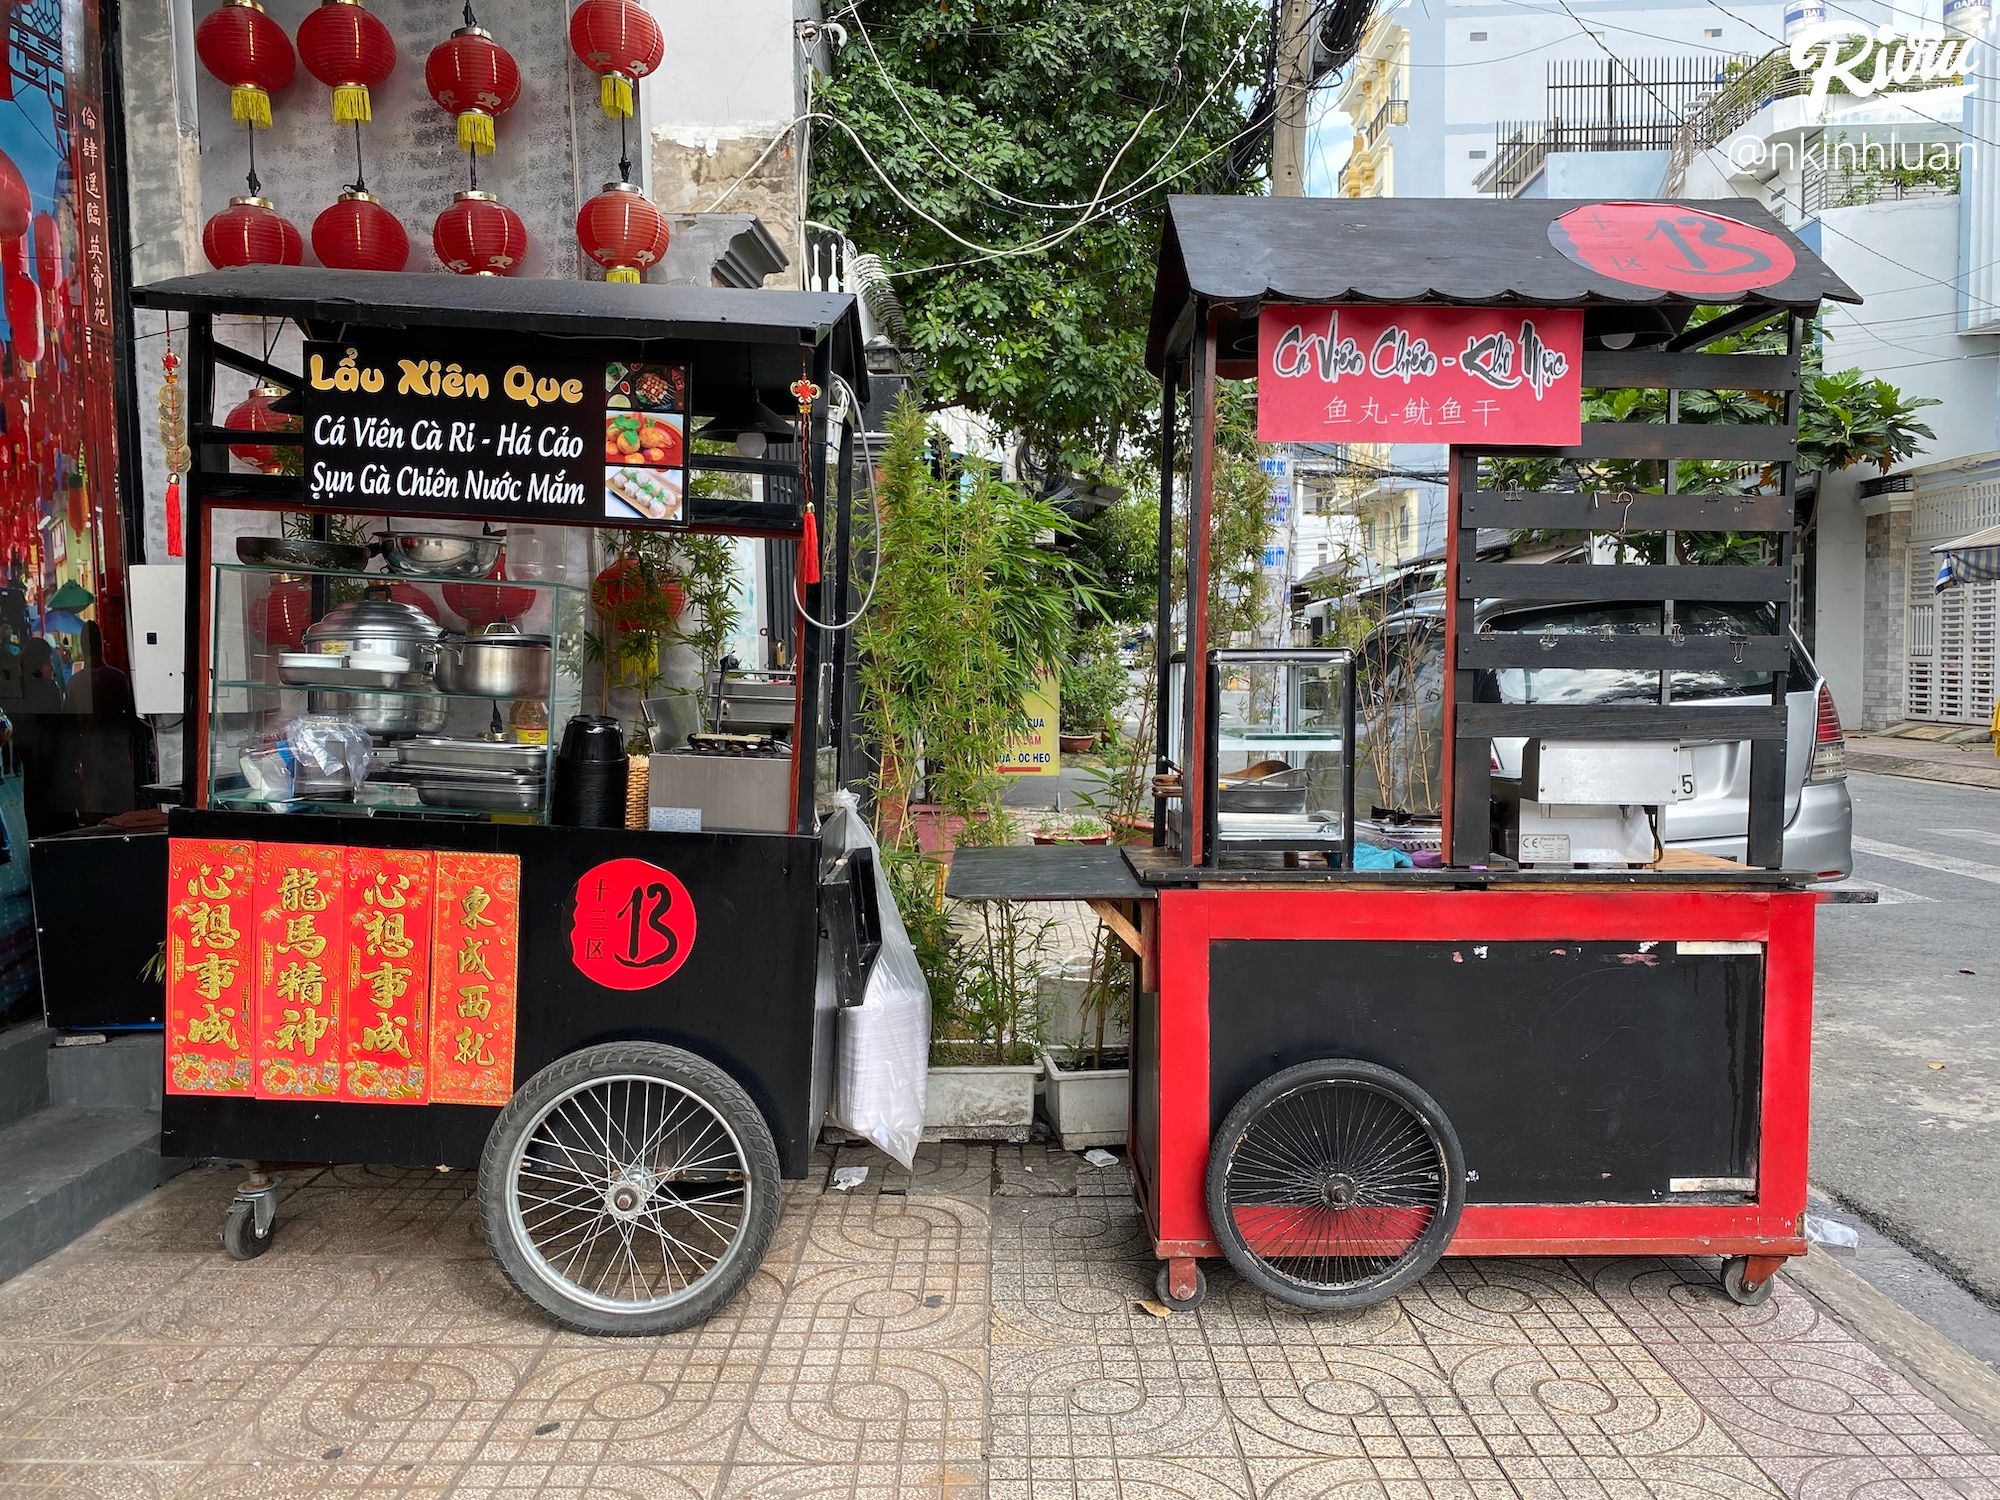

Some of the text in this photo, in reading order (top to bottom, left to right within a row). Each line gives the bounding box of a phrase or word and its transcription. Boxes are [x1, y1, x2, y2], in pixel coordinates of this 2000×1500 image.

[1645, 216, 1773, 276] 13
[310, 348, 584, 408] Lẩu Xiên Que
[1273, 324, 1318, 378] Cá
[1317, 309, 1365, 383] Viên
[1370, 324, 1437, 385] Chiên
[1461, 330, 1523, 390] Khô
[1519, 319, 1570, 401] Mực
[315, 415, 347, 446] Cá
[353, 417, 406, 449] Viên
[411, 420, 444, 451] Cà
[497, 421, 533, 457] Há
[538, 426, 584, 459] Cảo
[360, 464, 392, 495] Gà
[397, 466, 460, 499] Chiên
[465, 470, 523, 502] Nước
[527, 469, 586, 505] Mắm
[1033, 752, 1051, 763] HEO
[185, 862, 240, 1052] 心想事成
[586, 879, 610, 960] 十三区
[614, 882, 678, 967] 13
[274, 868, 332, 1057] 龍馬精神
[361, 871, 413, 1061] 心想事成
[453, 886, 496, 1066] 東成西就
